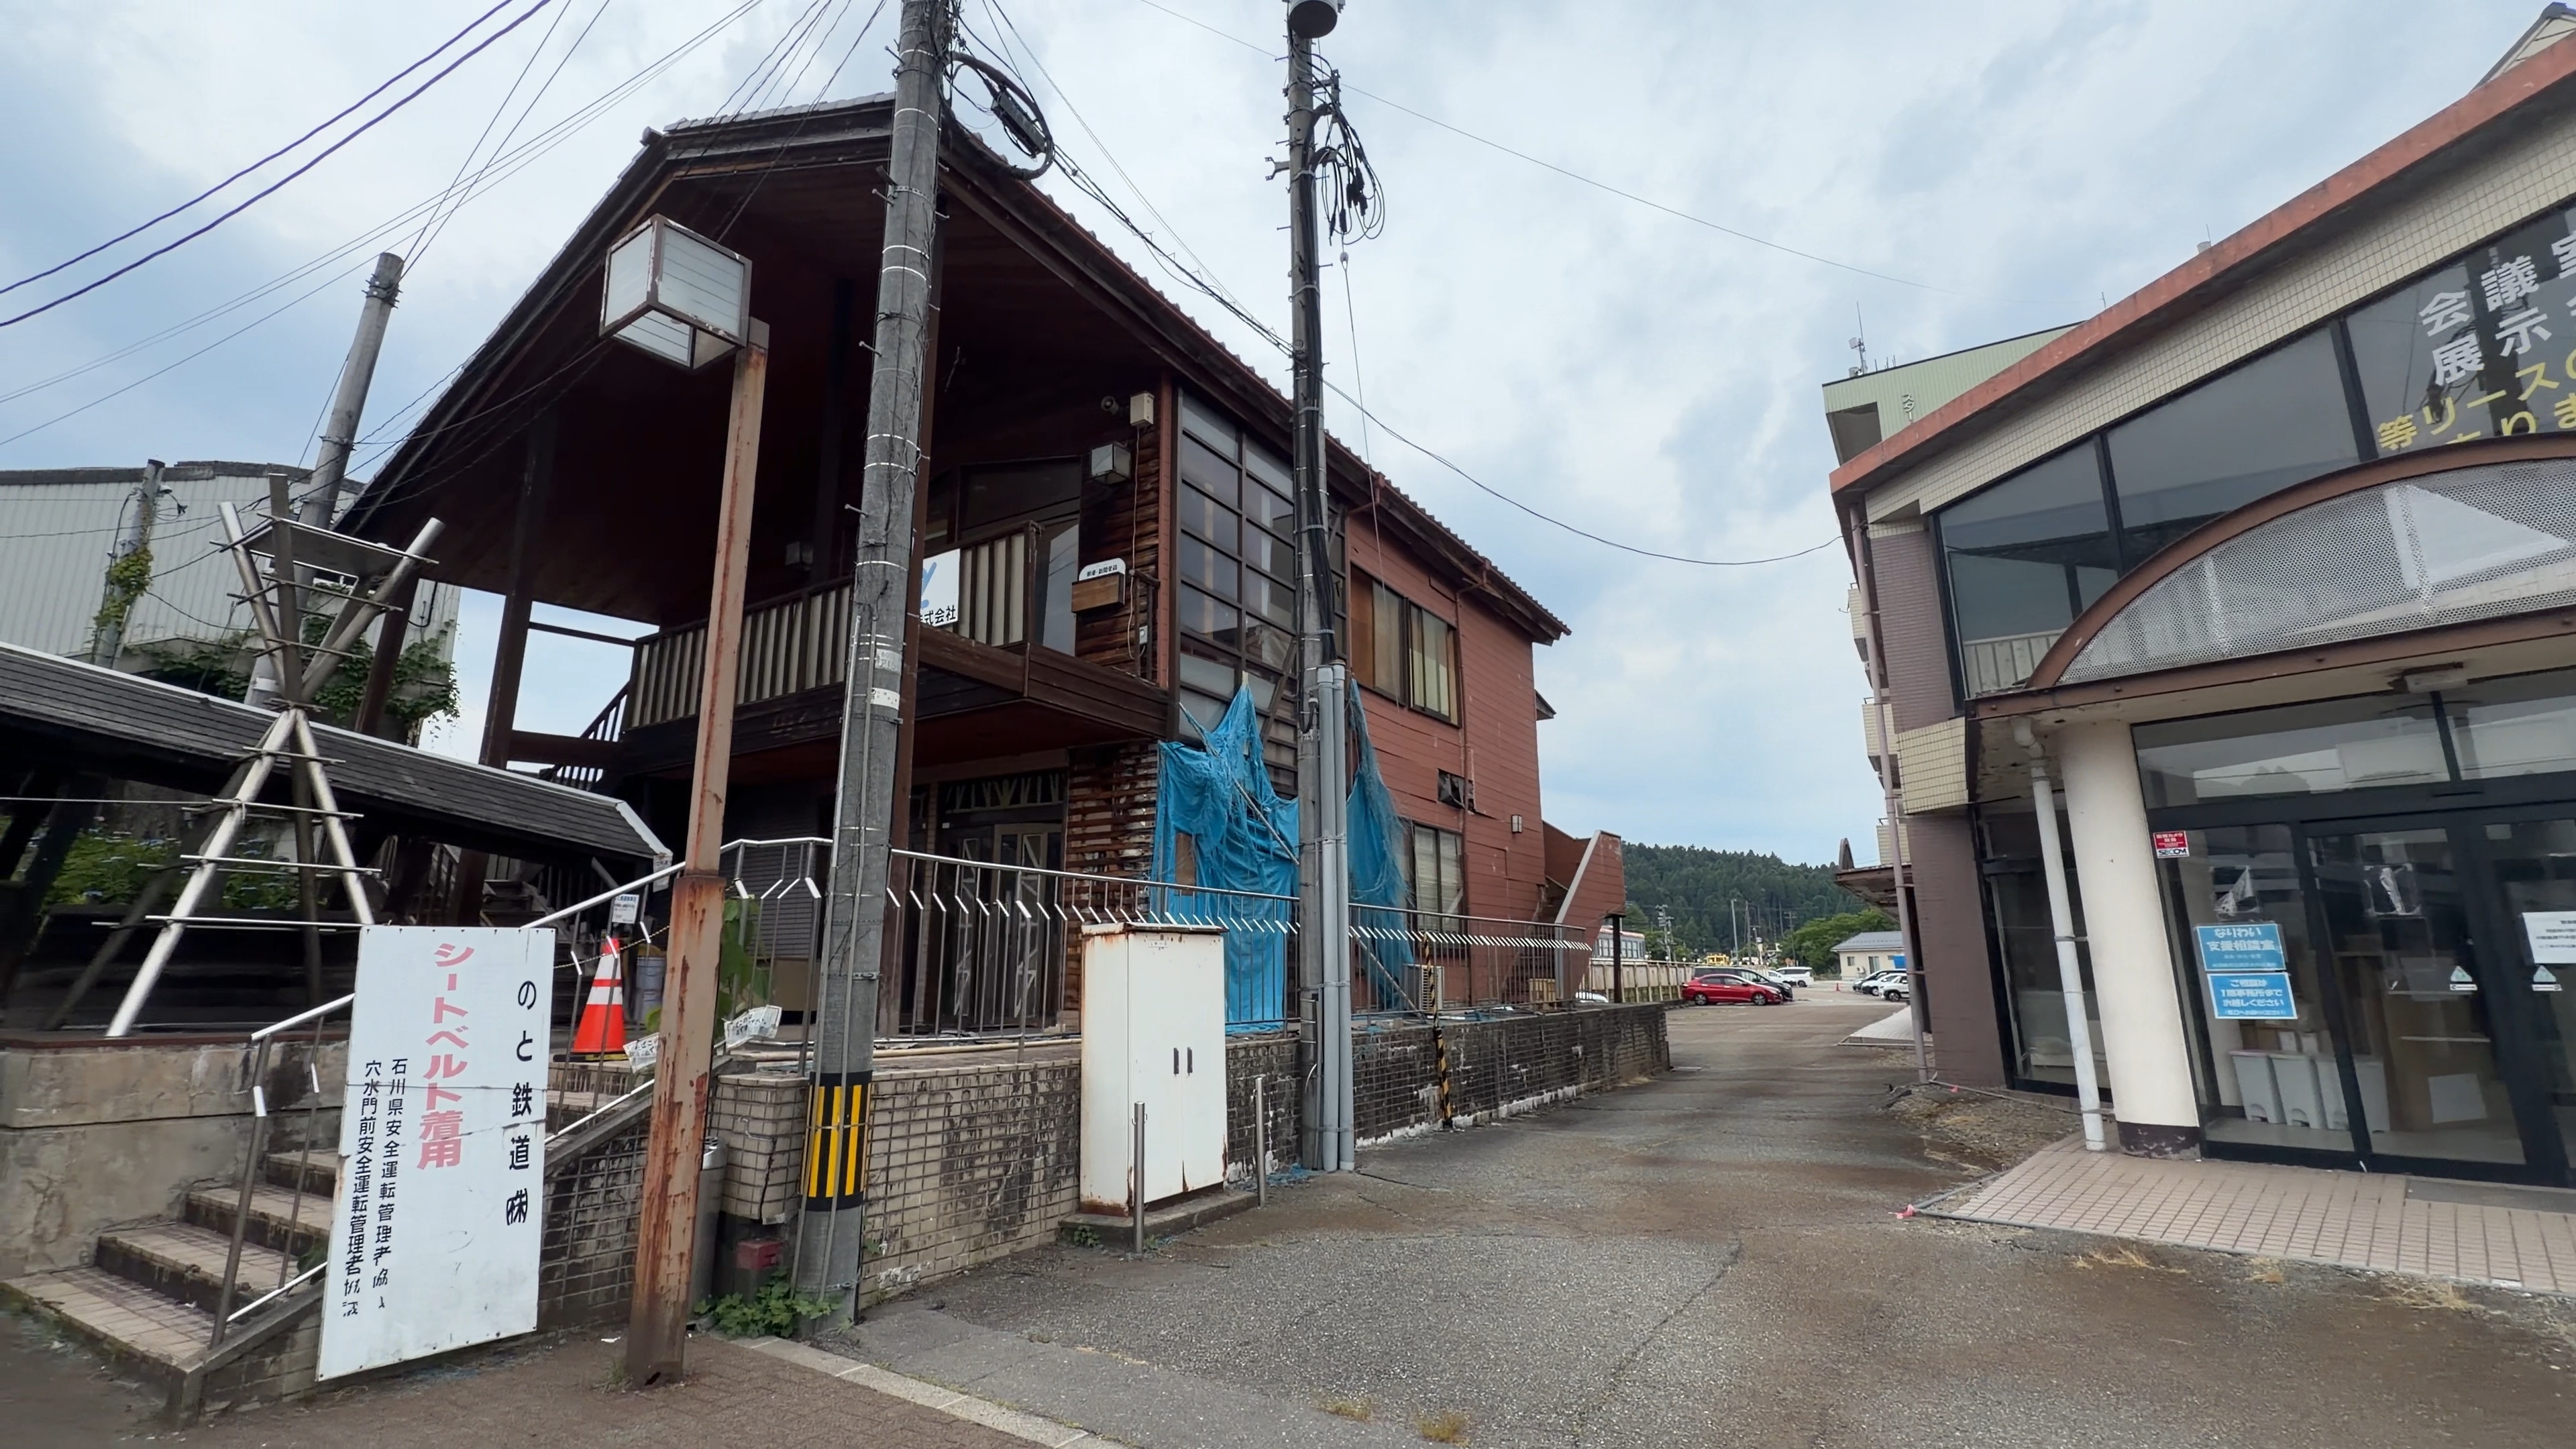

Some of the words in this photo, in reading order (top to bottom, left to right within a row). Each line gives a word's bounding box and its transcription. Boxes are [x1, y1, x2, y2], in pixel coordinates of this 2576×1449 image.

[2431, 297, 2576, 386] 展示
[2158, 848, 2187, 856] SECOM
[2214, 927, 2262, 938] なりわい
[417, 942, 475, 1171] シートベルト着用
[372, 1058, 409, 1309] 石川県安全運転管理者協
